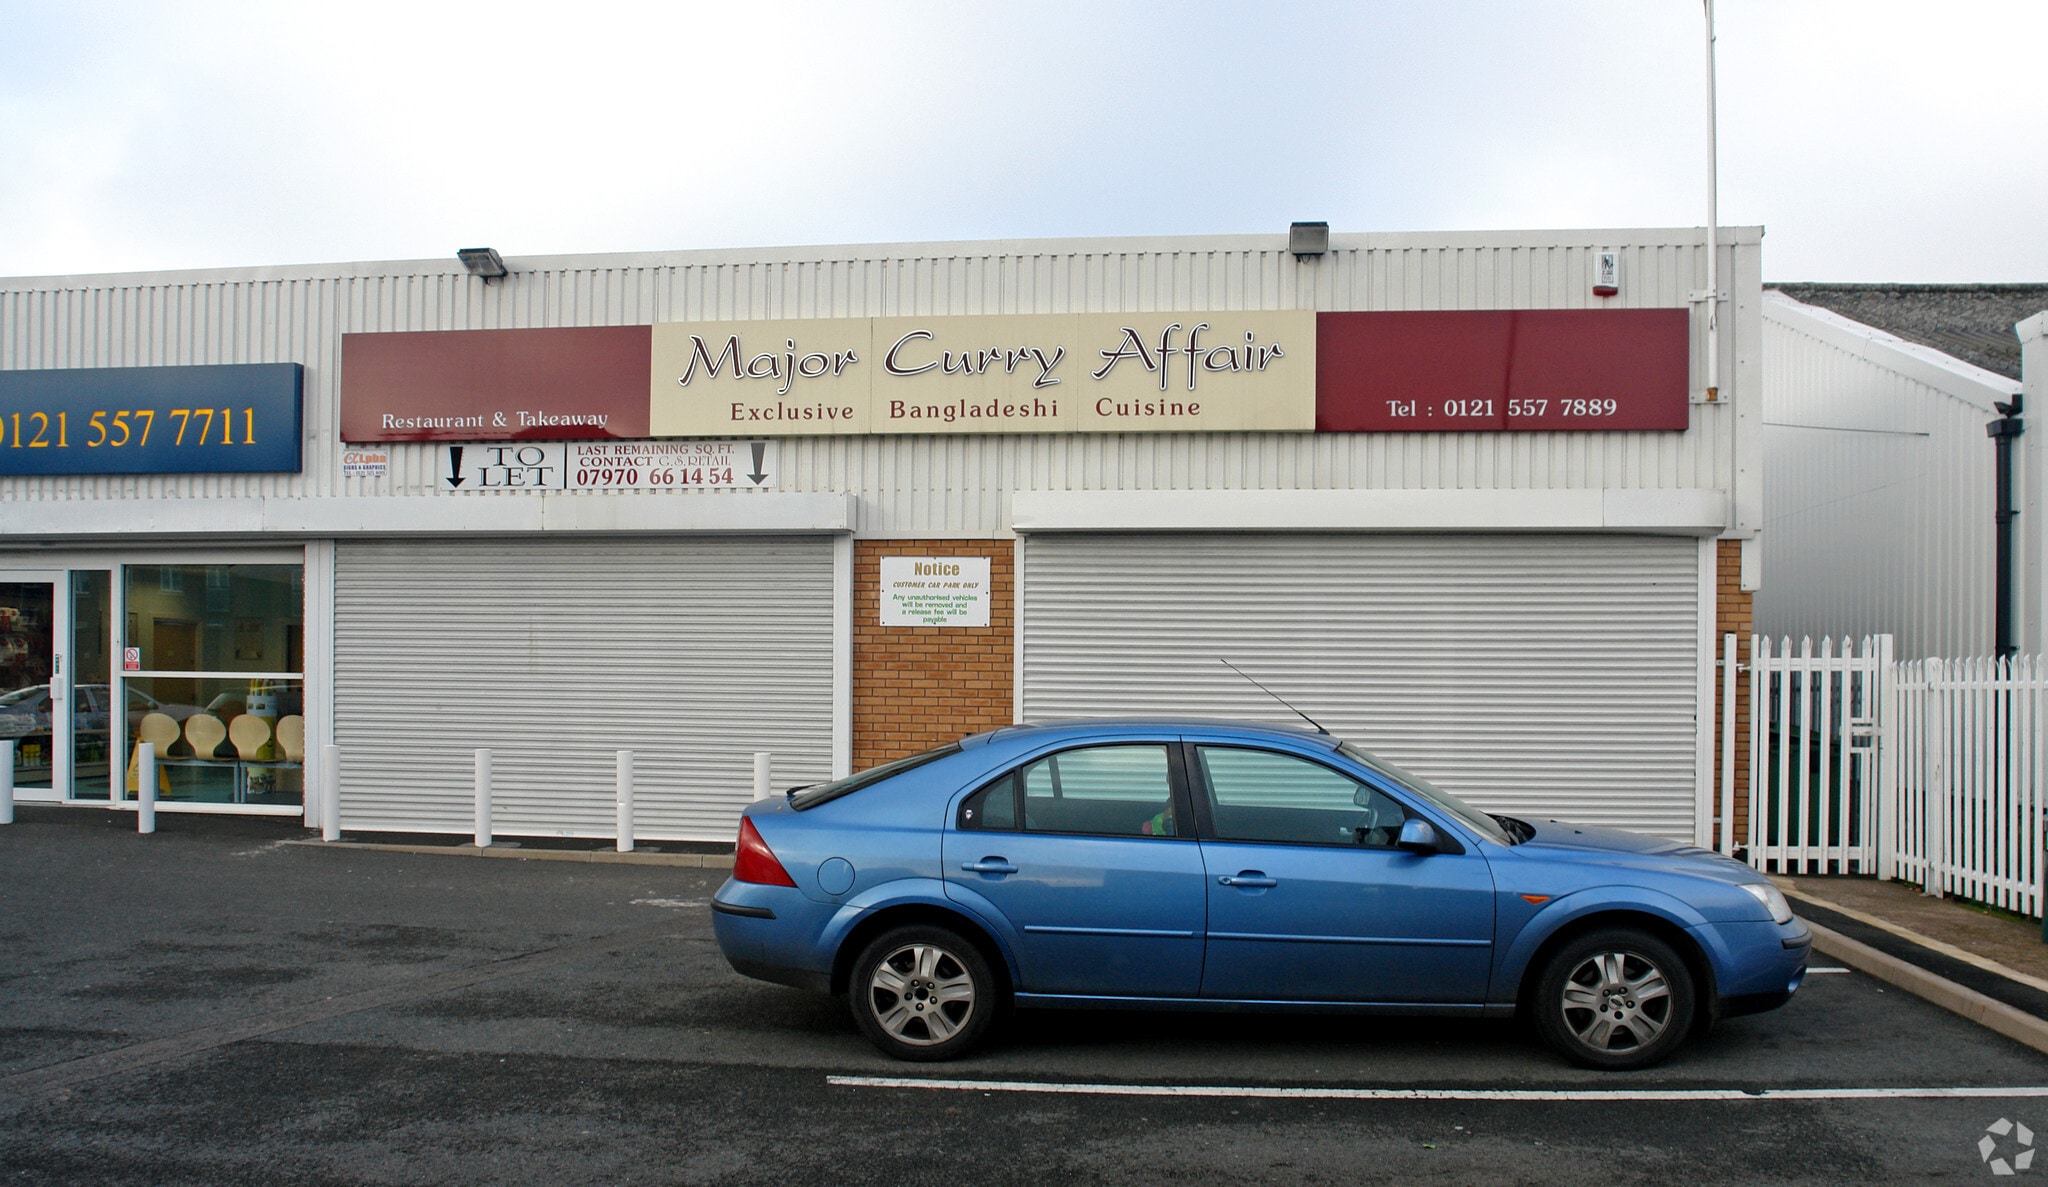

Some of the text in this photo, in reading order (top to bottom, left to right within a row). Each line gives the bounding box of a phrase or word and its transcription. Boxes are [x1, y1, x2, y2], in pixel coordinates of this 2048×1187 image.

[678, 322, 1284, 395] Major Curry Affair
[730, 397, 1201, 422] Exclusive Bangladeshi Cuisine
[1386, 400, 1416, 417] Tel
[1443, 399, 1494, 417] 0121
[1507, 399, 1548, 417] 557
[1560, 399, 1617, 417] 7889
[0, 407, 256, 448] 121 557 7711
[382, 410, 609, 429] Restaurant & Takeaway
[486, 446, 546, 467] TO
[577, 445, 608, 456] LAST
[615, 443, 689, 455] REMAINING
[579, 456, 654, 467] CONTACT
[478, 466, 554, 487] LET
[577, 468, 638, 486] 07970
[914, 562, 960, 576] Notice
[892, 581, 925, 589] CUSTOMER
[928, 581, 941, 589] CAR
[907, 593, 950, 601] unauthorised
[922, 616, 947, 624] payable
